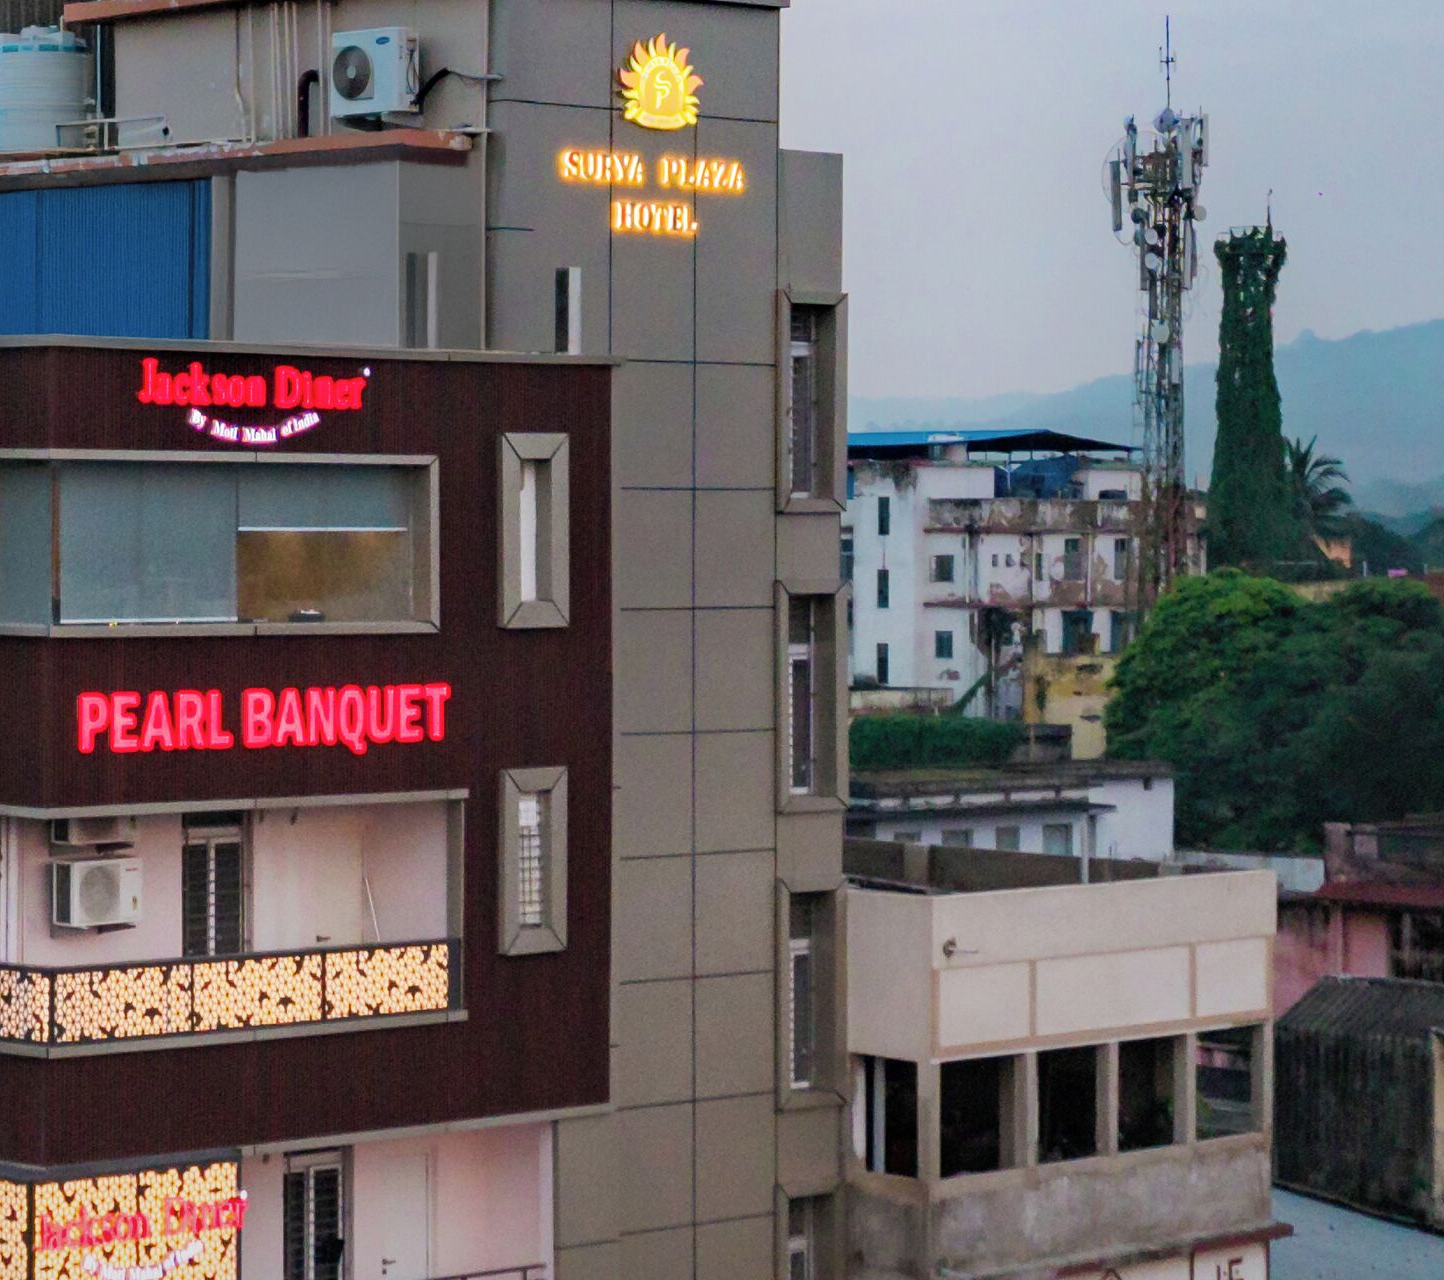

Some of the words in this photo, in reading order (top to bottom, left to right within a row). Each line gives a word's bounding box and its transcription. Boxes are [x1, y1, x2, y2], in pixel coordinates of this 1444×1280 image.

[559, 149, 644, 186] SURYA
[659, 156, 746, 193] PLAZA
[612, 201, 699, 234] HOTEL
[138, 357, 267, 407] Jackson
[273, 365, 367, 411] Diner
[189, 407, 207, 430] By
[241, 426, 278, 443] Mahal
[78, 691, 233, 754] PEARL
[243, 682, 452, 755] BANQUET
